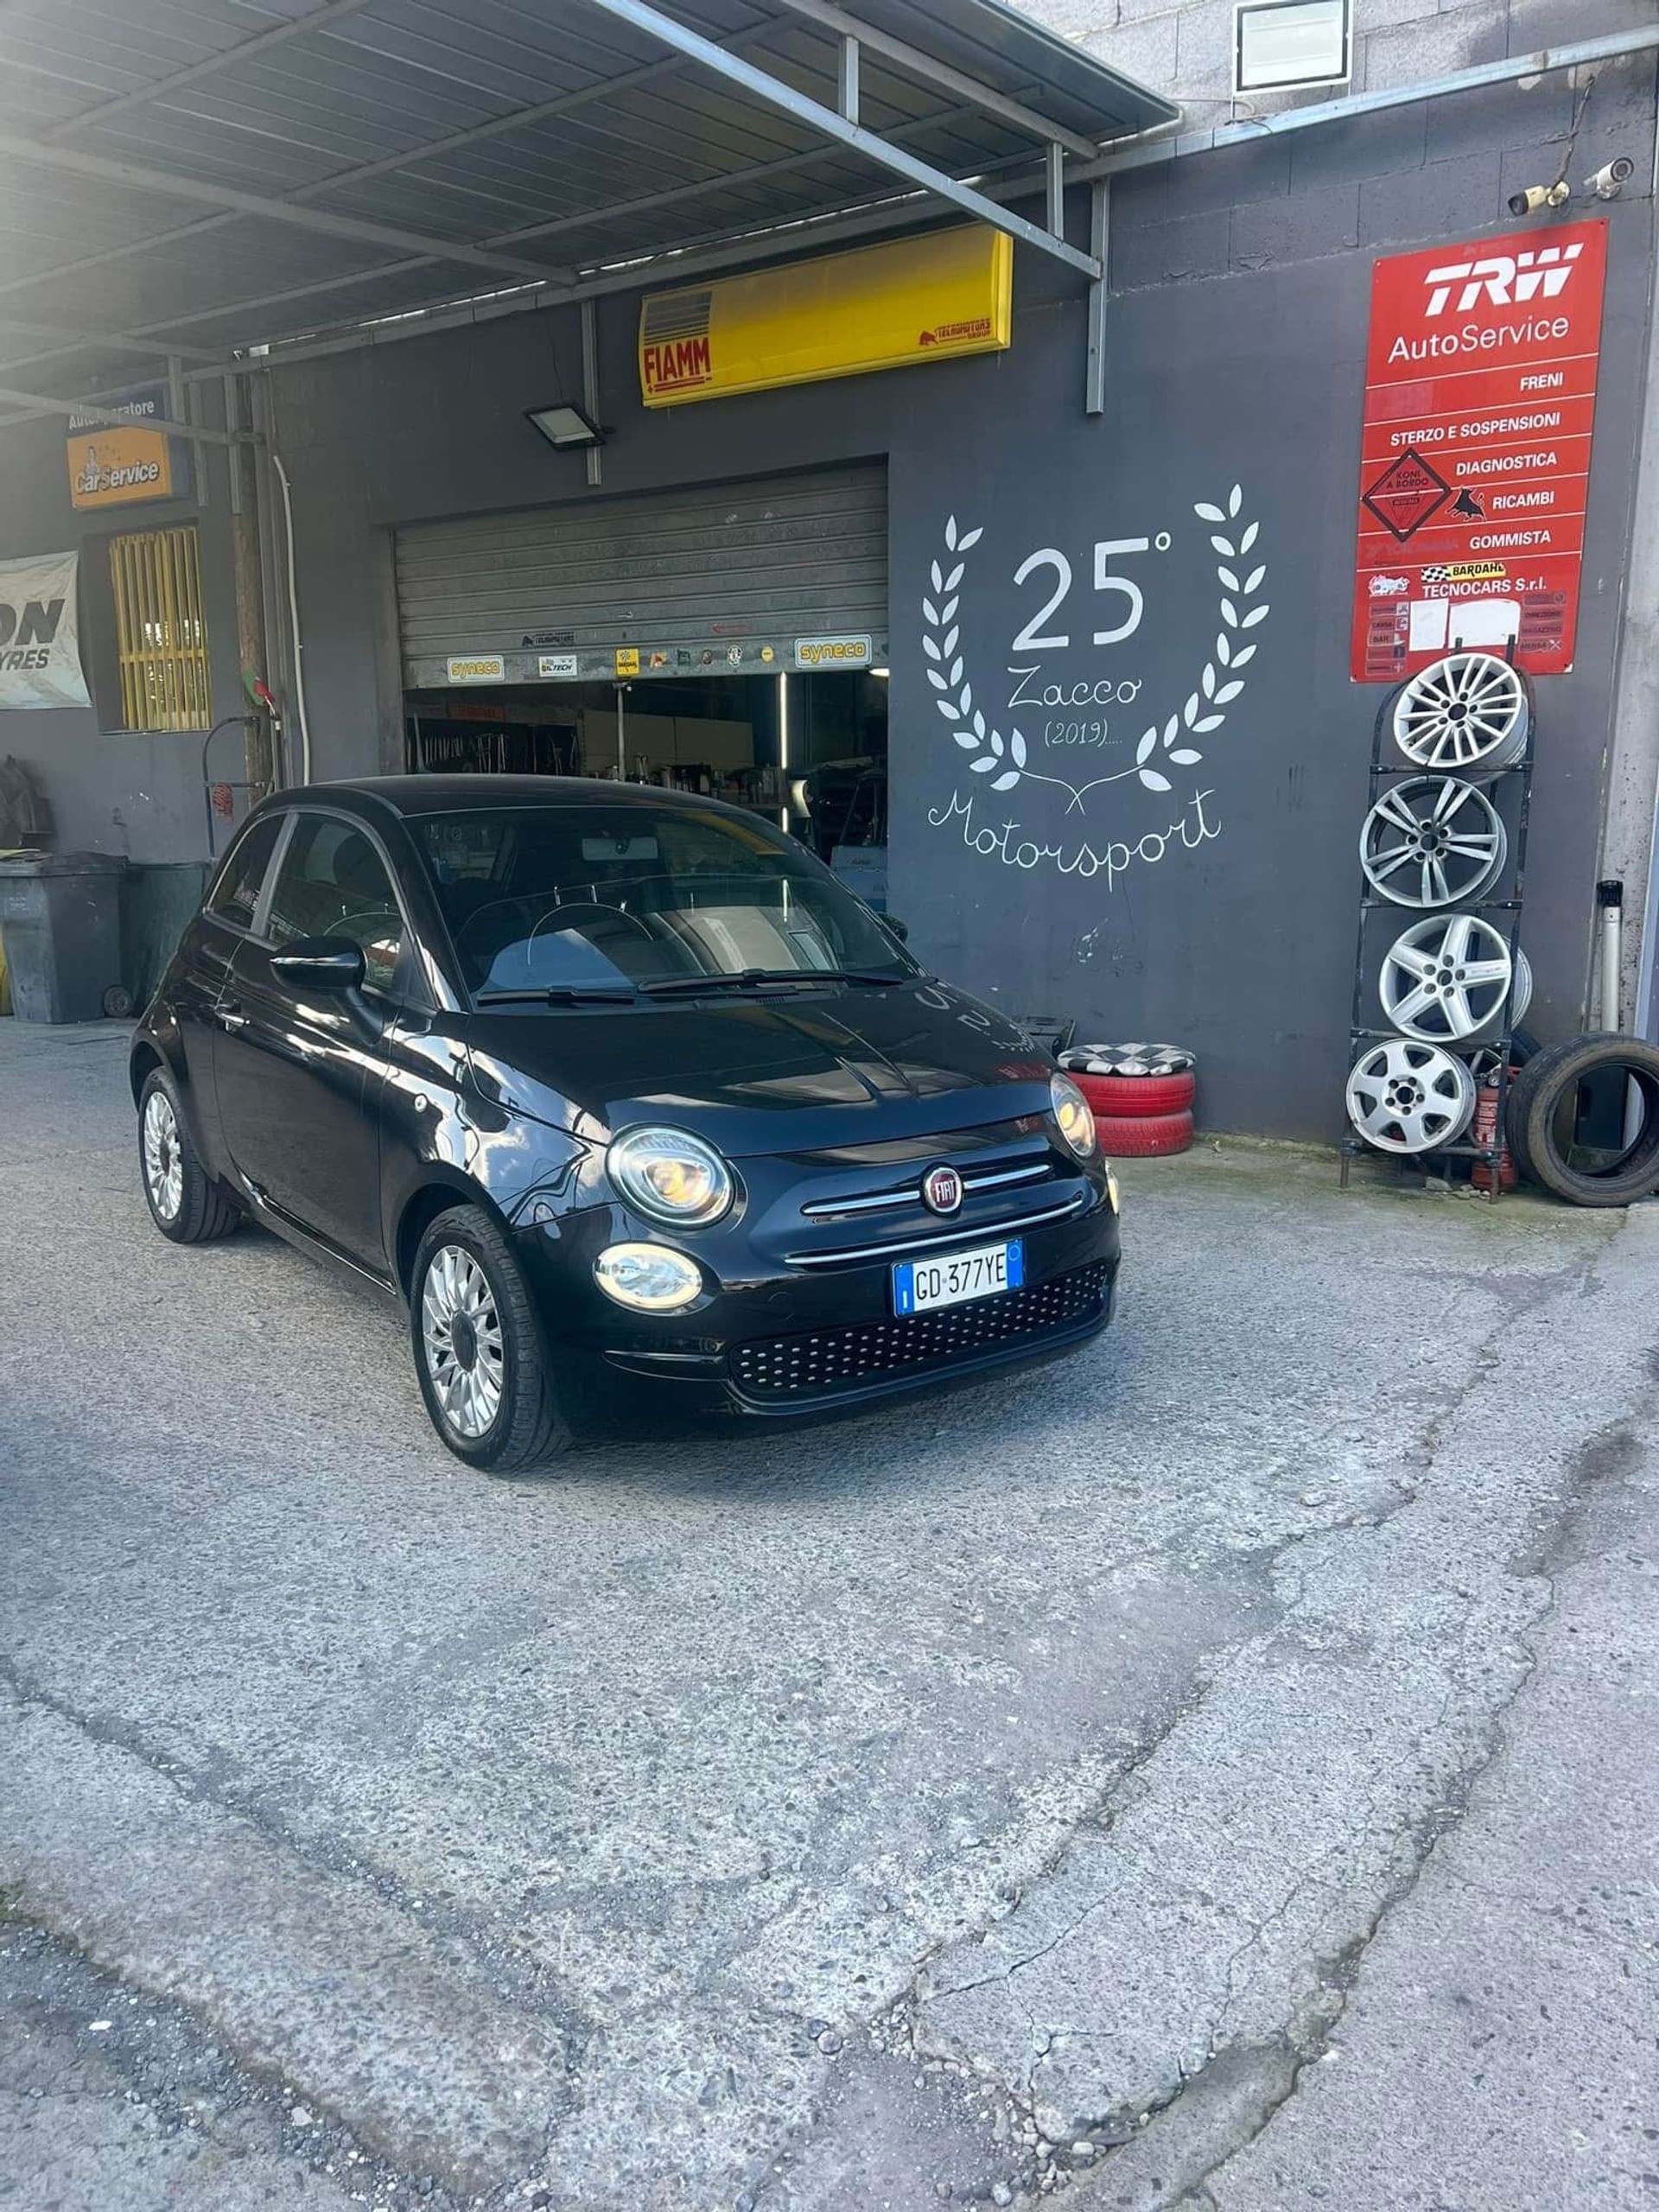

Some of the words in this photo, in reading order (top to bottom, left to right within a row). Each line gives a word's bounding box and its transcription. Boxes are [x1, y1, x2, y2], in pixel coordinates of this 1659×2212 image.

[1424, 243, 1585, 317] TRW
[1388, 315, 1569, 363] AutoService
[644, 337, 711, 385] FIAMM
[1520, 372, 1564, 391] FRENI
[1390, 427, 1445, 447] STERZO
[1447, 425, 1458, 439] E
[1460, 412, 1561, 437] SOSPENSIONI
[1396, 470, 1421, 479] KONI
[1456, 452, 1557, 476] DIAGNOSTICA
[76, 461, 159, 494] CarService
[1396, 478, 1429, 487] BORDO
[1492, 491, 1554, 510] RICAMBI
[1470, 530, 1551, 550] GOMMISTA
[1452, 563, 1504, 577] BARDAHL
[1422, 579, 1511, 598] TECNOCARS
[1515, 576, 1547, 592] S.r.l.
[801, 641, 865, 664] syneco
[451, 660, 499, 678] syneco
[1007, 665, 1141, 709] Zacco
[928, 789, 1222, 893] Motorsport
[936, 1180, 955, 1202] FIAT
